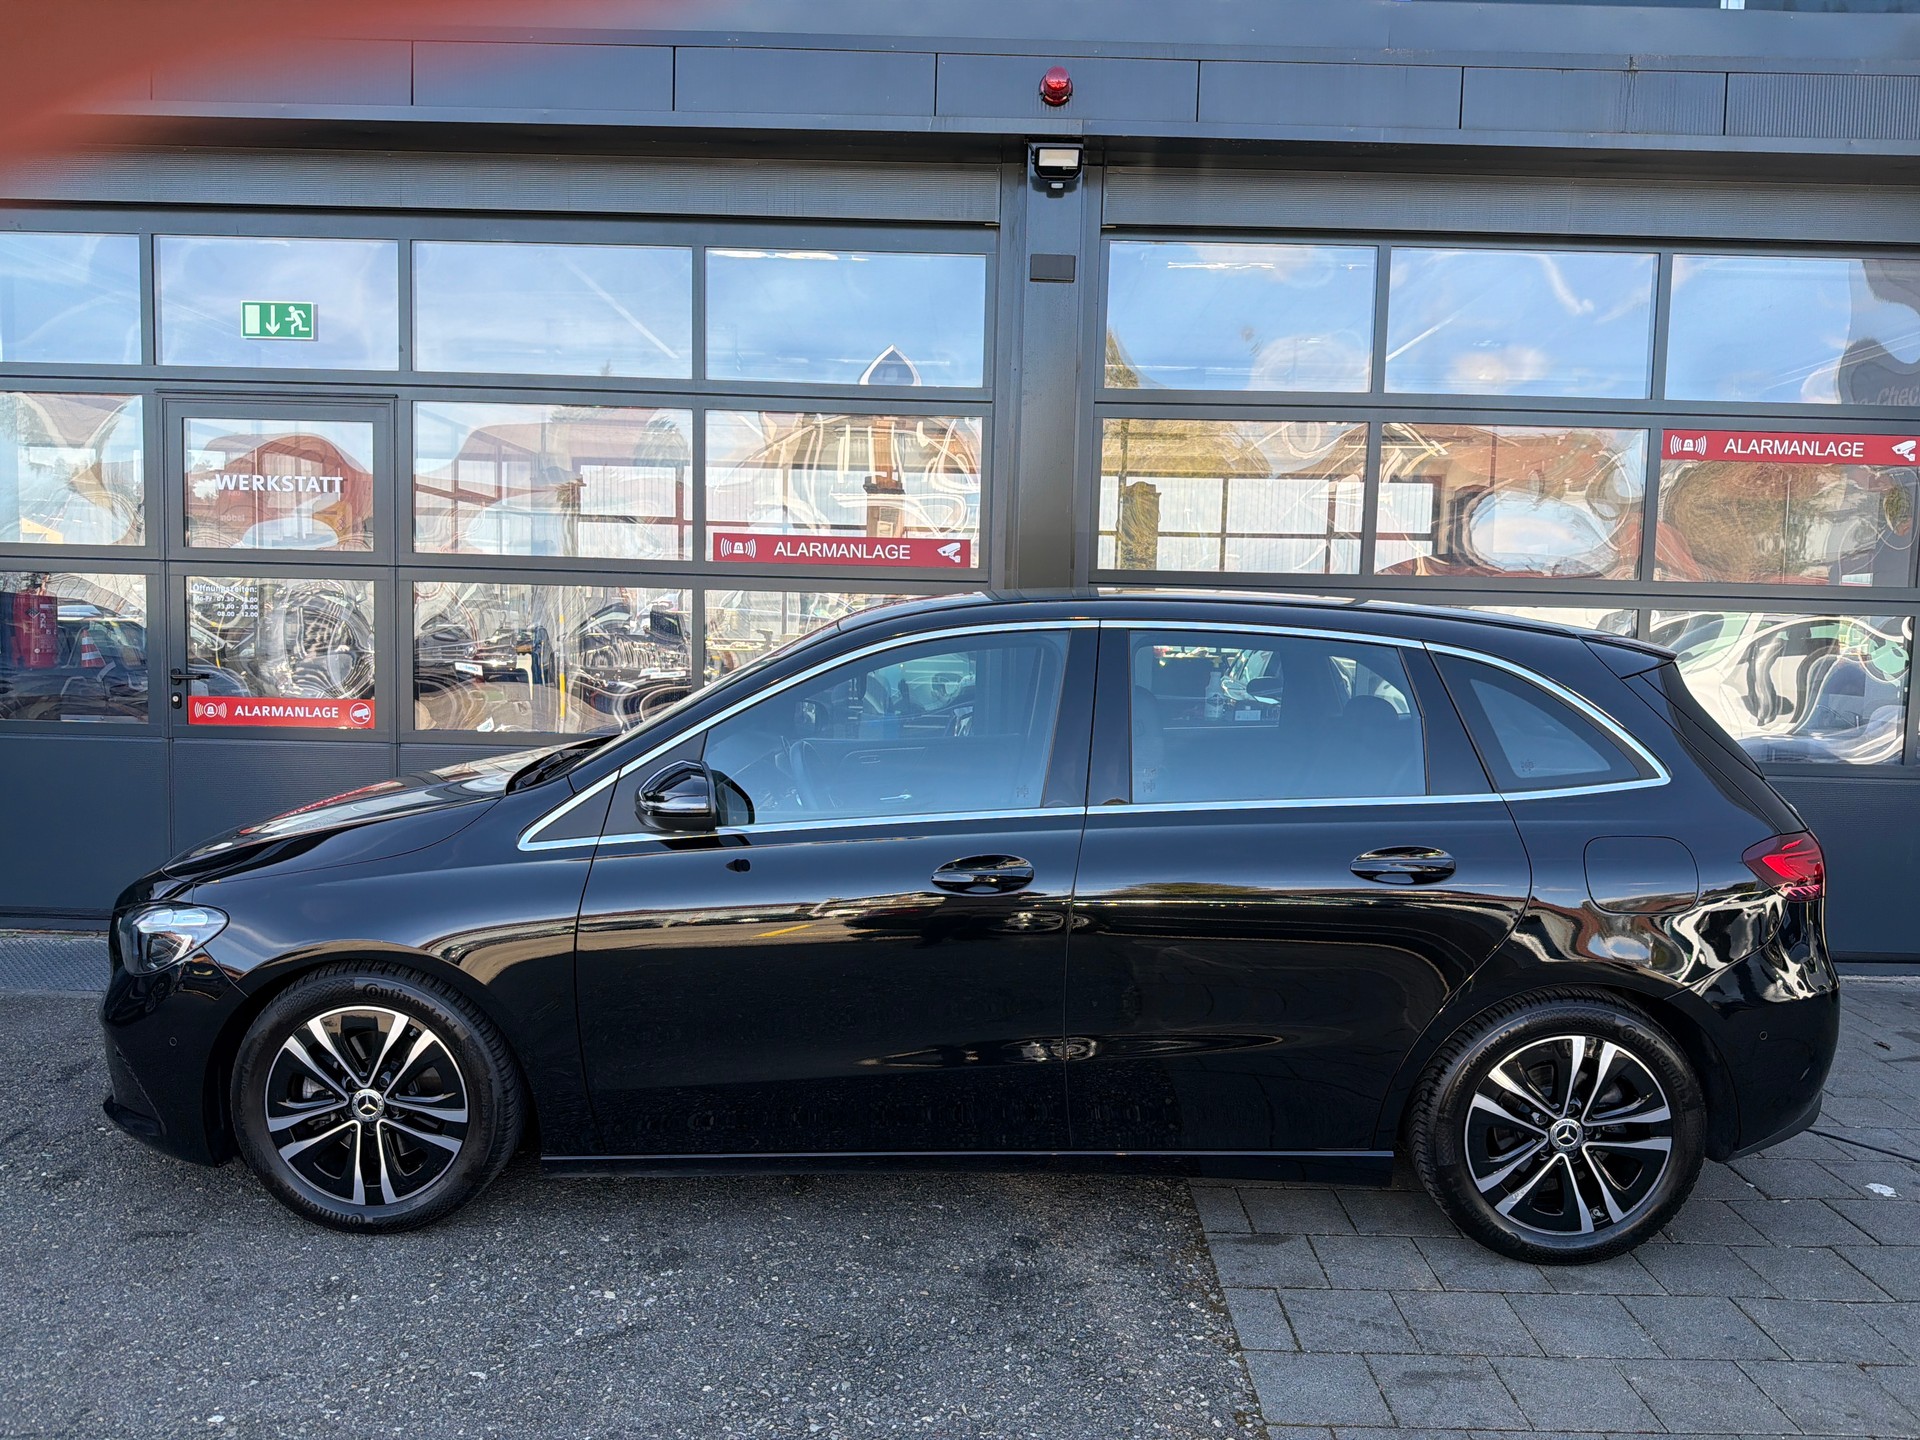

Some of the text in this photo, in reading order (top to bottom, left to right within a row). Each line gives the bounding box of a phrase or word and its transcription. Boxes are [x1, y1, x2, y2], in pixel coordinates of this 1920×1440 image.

[1724, 438, 1865, 457] ALARMANLAGE
[215, 474, 343, 493] WERKSTATT
[774, 542, 911, 560] ALARMANLAGE
[234, 705, 339, 718] ALARMANLAGE
